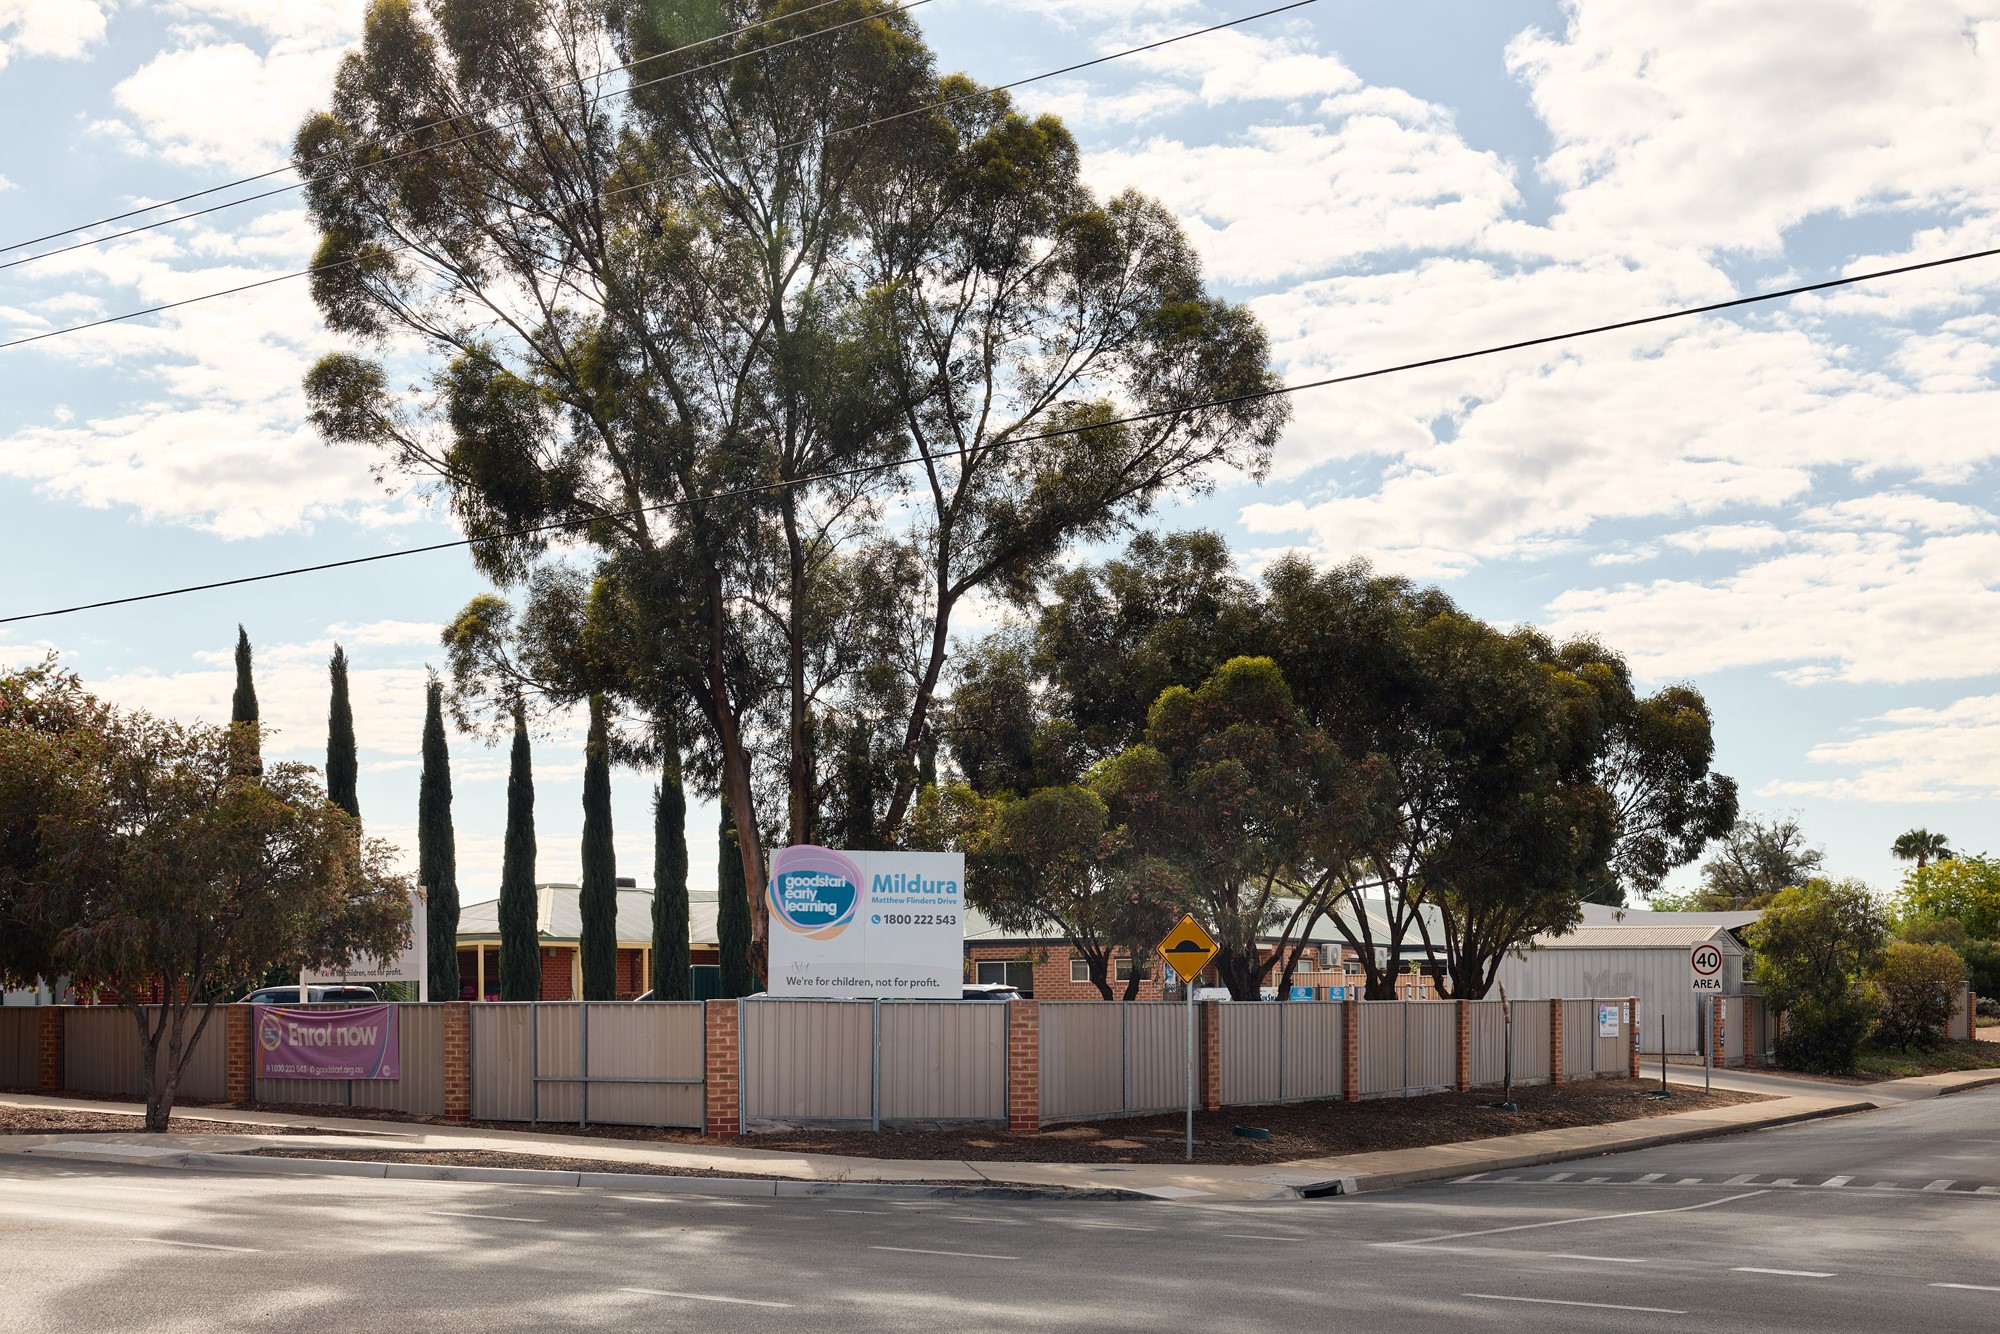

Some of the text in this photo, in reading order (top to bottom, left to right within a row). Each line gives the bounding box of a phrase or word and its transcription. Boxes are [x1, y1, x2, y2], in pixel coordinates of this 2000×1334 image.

[785, 874, 847, 889] goodstart
[872, 874, 957, 894] Mildura
[785, 888, 817, 901] early
[938, 897, 957, 905] Drive
[785, 900, 837, 915] learning
[884, 914, 956, 925] 1800 222 543
[1696, 952, 1718, 968] 40
[386, 967, 403, 978] profit.
[786, 976, 940, 990] We're for children, not for profit.
[1693, 979, 1721, 989] AREA
[288, 1022, 332, 1047] Enrol
[336, 1026, 378, 1047] now
[271, 1064, 364, 1076] 1800 222 543 goodstart.org.au
